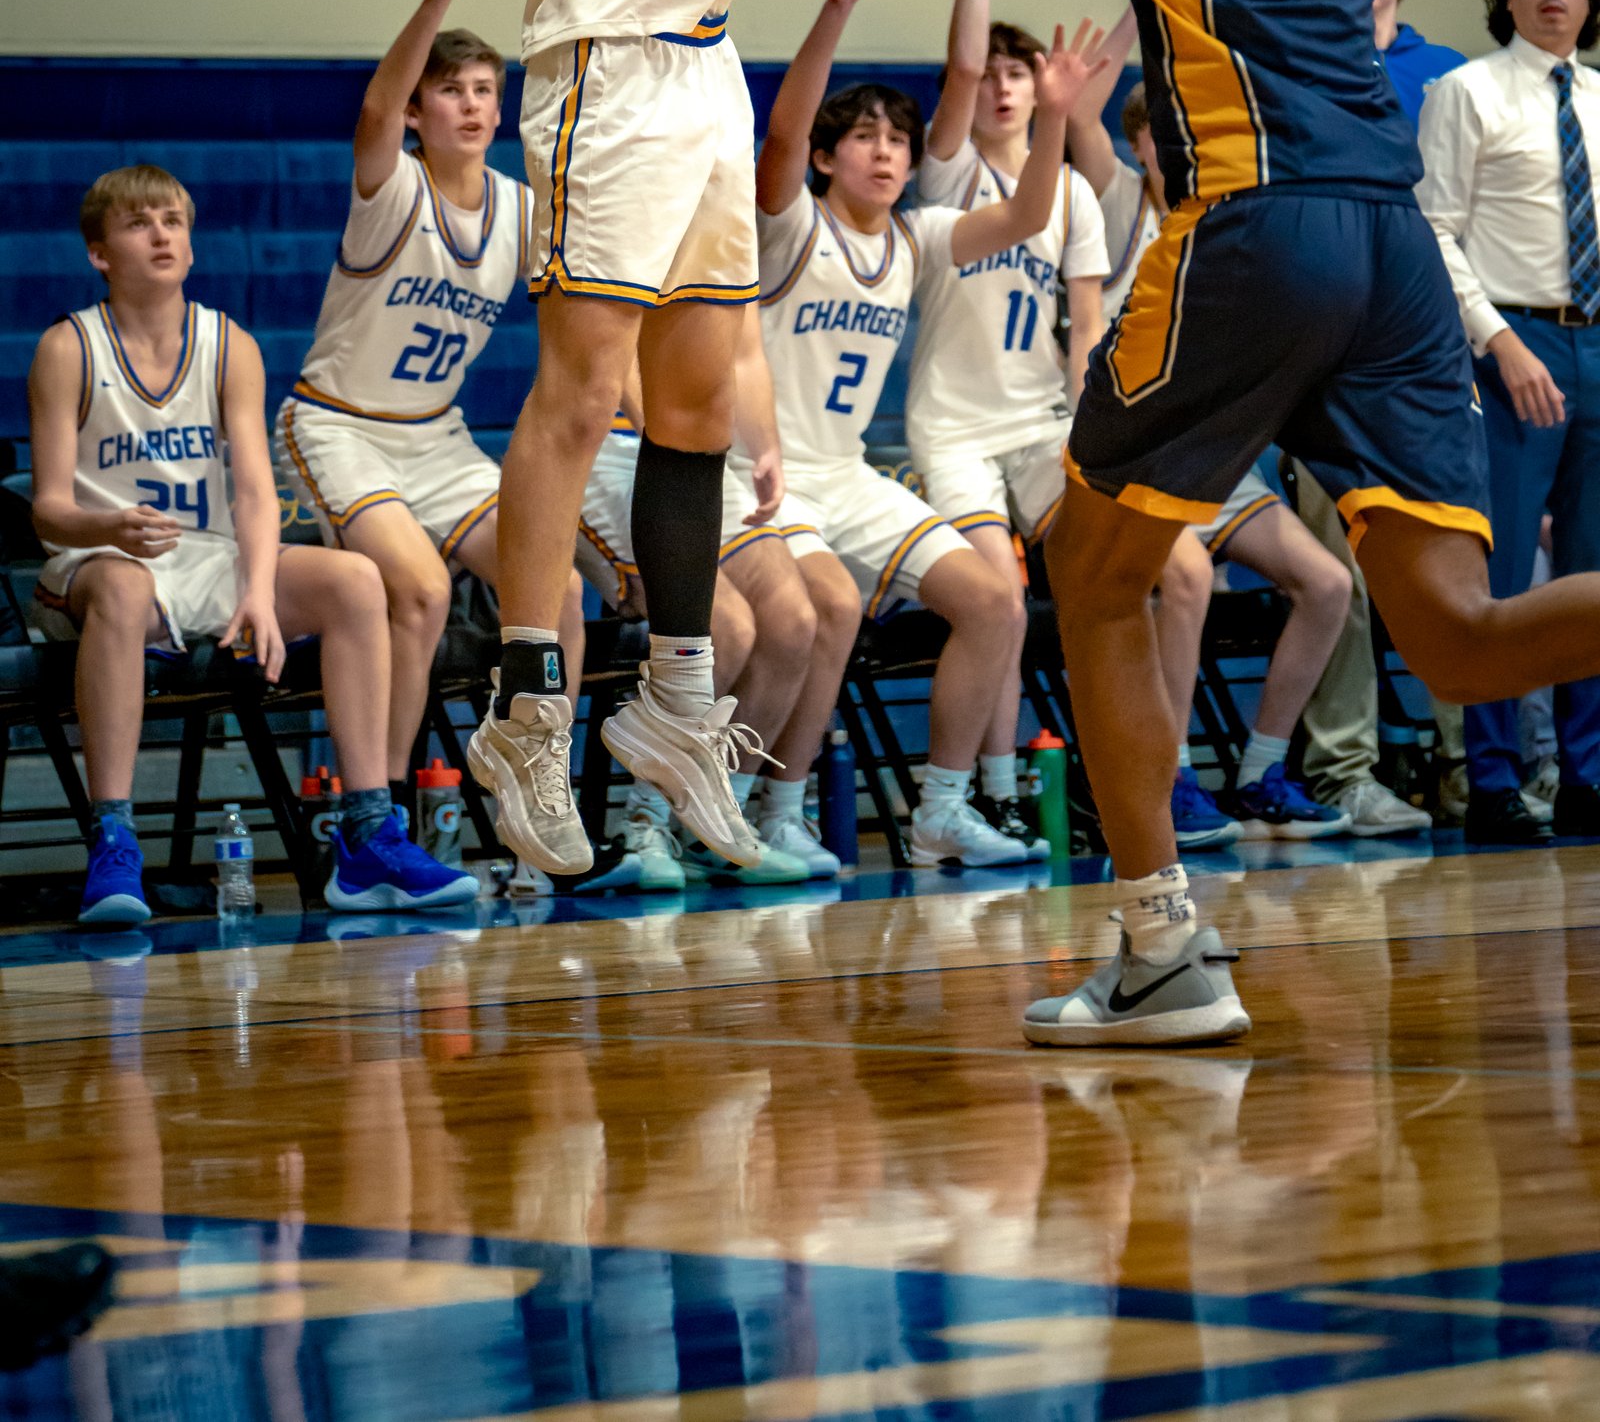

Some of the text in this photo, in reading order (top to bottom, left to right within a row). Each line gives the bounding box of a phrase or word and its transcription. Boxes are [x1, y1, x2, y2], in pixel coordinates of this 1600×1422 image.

[1004, 289, 1039, 351] 11
[391, 322, 468, 383] 20
[825, 351, 868, 414] 2
[136, 478, 209, 529] 24
